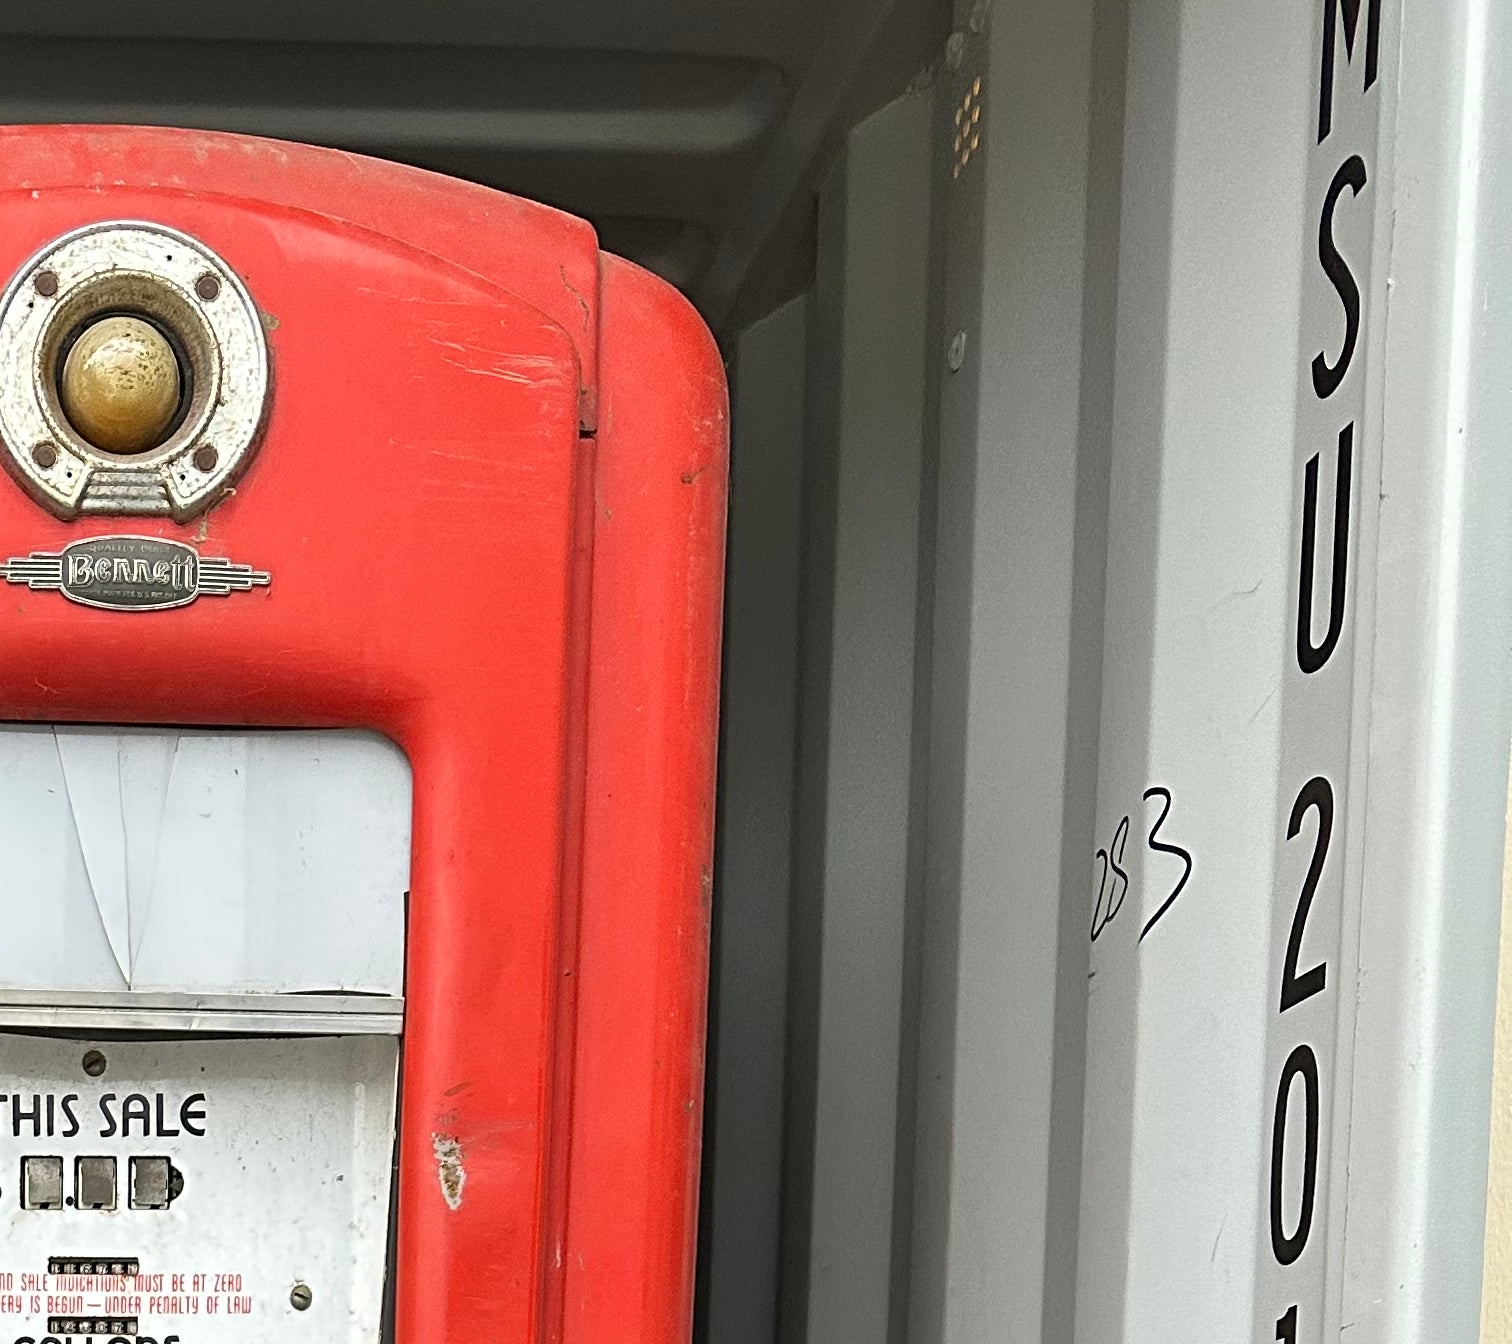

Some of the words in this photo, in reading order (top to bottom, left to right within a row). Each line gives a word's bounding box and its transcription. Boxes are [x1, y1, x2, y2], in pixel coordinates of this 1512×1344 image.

[99, 1093, 207, 1138] SALE
[21, 1273, 48, 1292] SALE
[134, 1273, 165, 1292] MUST
[172, 1273, 185, 1292] BE
[192, 1273, 207, 1292] AT
[214, 1274, 242, 1292] ZERO
[30, 1295, 40, 1313] IS
[47, 1296, 83, 1314] BEGUN
[105, 1296, 141, 1314] UNDER
[149, 1296, 199, 1314] PENALTY
[206, 1296, 219, 1314] OF
[227, 1296, 252, 1314] LAW
